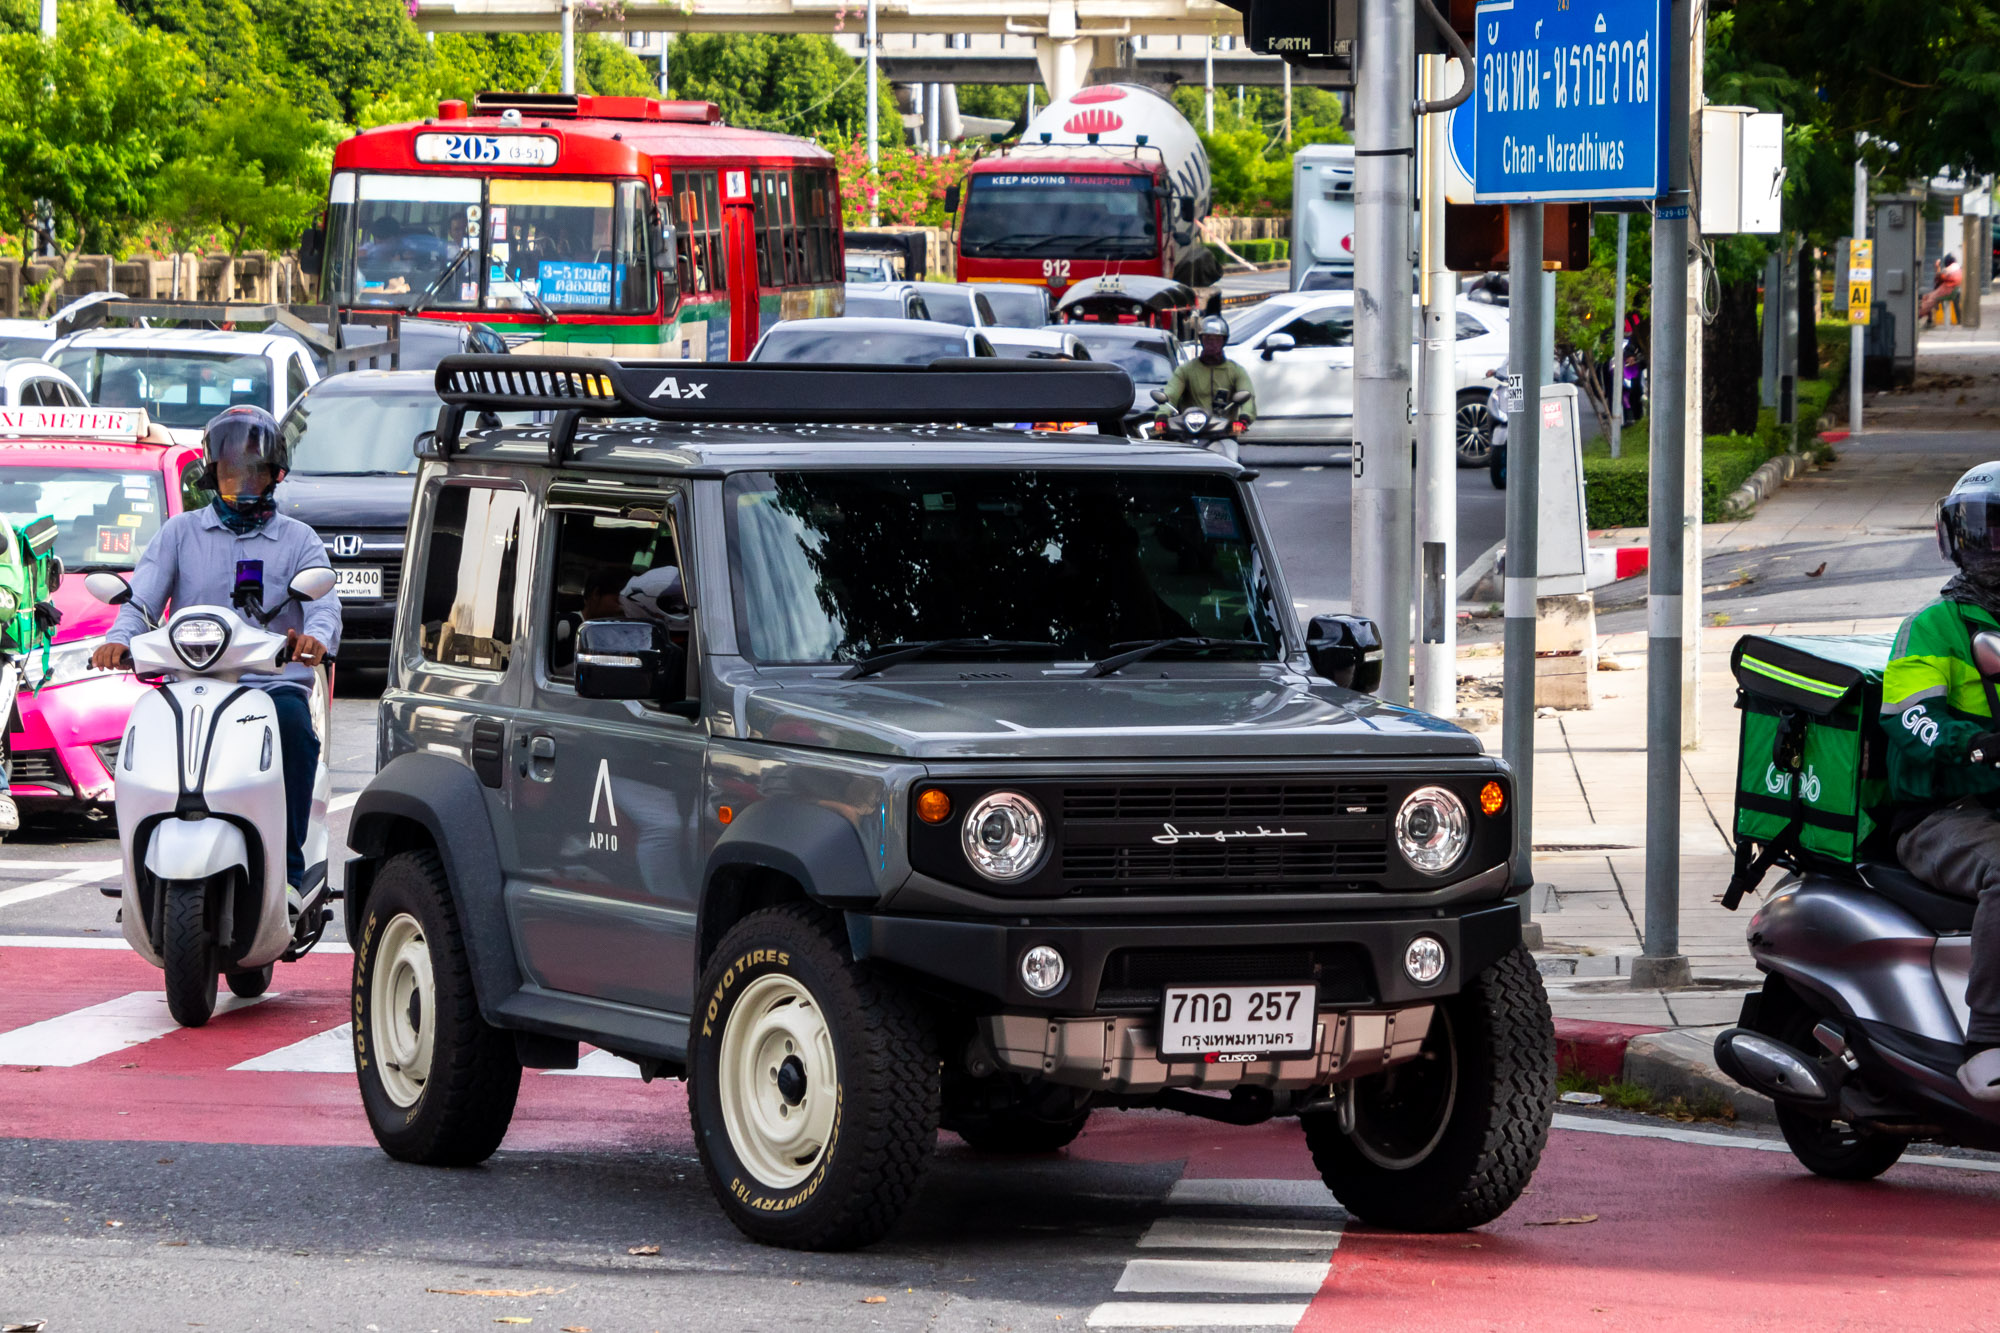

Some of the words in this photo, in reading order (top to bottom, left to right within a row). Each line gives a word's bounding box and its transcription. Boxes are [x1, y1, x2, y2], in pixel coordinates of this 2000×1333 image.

[1268, 37, 1311, 50] FORTH
[1483, 13, 1649, 112] จันทน์-นราธิวาส
[446, 135, 500, 161] 205
[509, 147, 545, 161] (3-51)
[992, 176, 1019, 185] KEEP
[1021, 176, 1066, 185] MOVING
[1069, 176, 1132, 186] TRANSPORT
[1042, 259, 1071, 277] 912
[1852, 288, 1867, 304] AI
[347, 571, 379, 584] 2400
[1901, 705, 1940, 747] Gra
[589, 831, 618, 852] APIO
[356, 911, 377, 986] TIRES
[702, 968, 735, 1038] TOYO
[735, 949, 790, 975] TIRES
[1172, 993, 1232, 1023] 7กอ
[1247, 991, 1301, 1021] 257
[355, 993, 368, 1071] TOYO
[1182, 1032, 1294, 1051] กรุงเทพมหานคร
[827, 1082, 843, 1165] OPEN
[751, 1170, 826, 1212] COUNTRY
